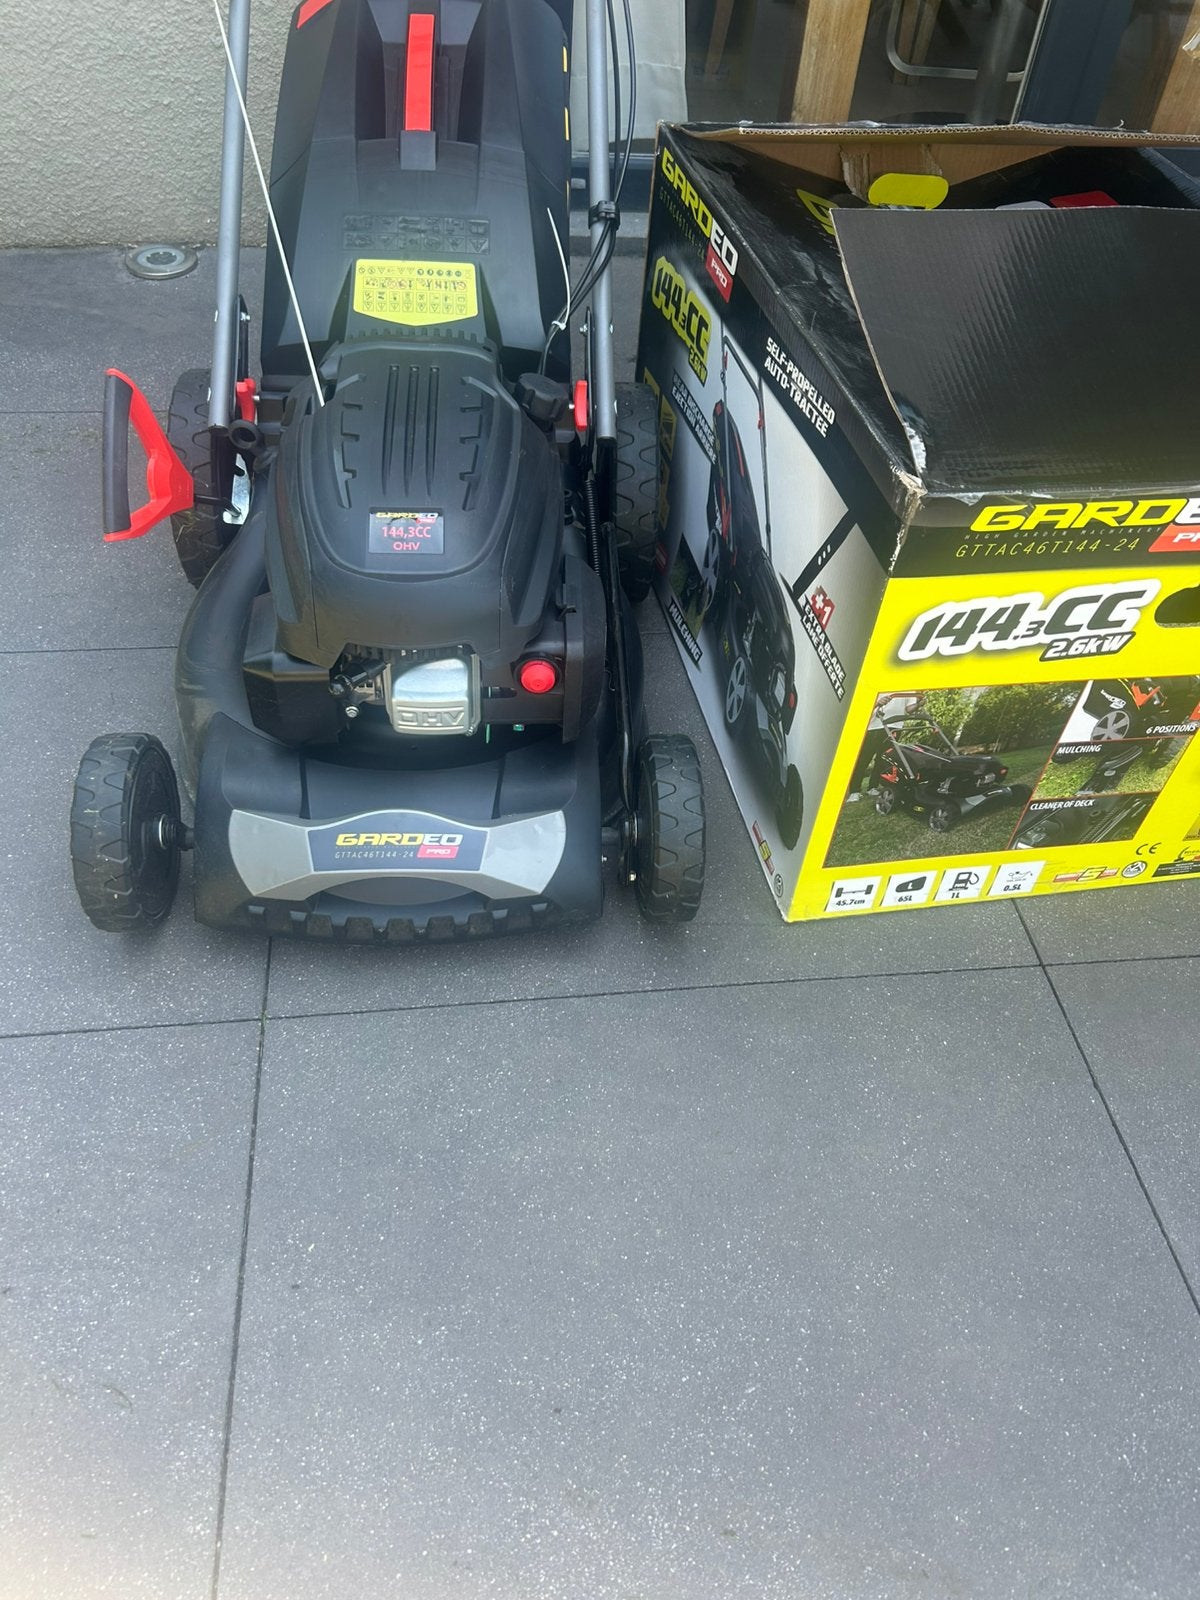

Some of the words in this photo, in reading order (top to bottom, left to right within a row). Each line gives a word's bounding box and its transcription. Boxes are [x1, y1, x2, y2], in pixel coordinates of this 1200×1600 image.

[661, 146, 739, 276] GARDEO
[710, 258, 728, 288] PRO
[766, 336, 836, 425] SELF-PROPELLED
[970, 497, 1200, 532] GARDE
[381, 526, 432, 539] 144,3CC
[393, 541, 421, 551] OHV
[955, 537, 1141, 557] GTTAC46T144-24
[669, 603, 701, 661] MULCHING
[804, 604, 826, 645] EXTRA
[824, 642, 846, 683] BLADE
[803, 615, 820, 648] LAME
[817, 645, 845, 699] OFFERTE
[399, 710, 465, 727] OHV
[1145, 726, 1153, 735] 6
[1153, 723, 1198, 734] POSITIONS
[1056, 745, 1102, 755] MULCHING
[1030, 801, 1063, 811] CLEANER
[1063, 800, 1074, 808] OF
[1074, 799, 1096, 808] DECK
[336, 832, 463, 846] GARDEO
[335, 851, 415, 859] GTTAC46T144-24
[1136, 842, 1162, 855] CE
[835, 898, 866, 906] 45.7cm
